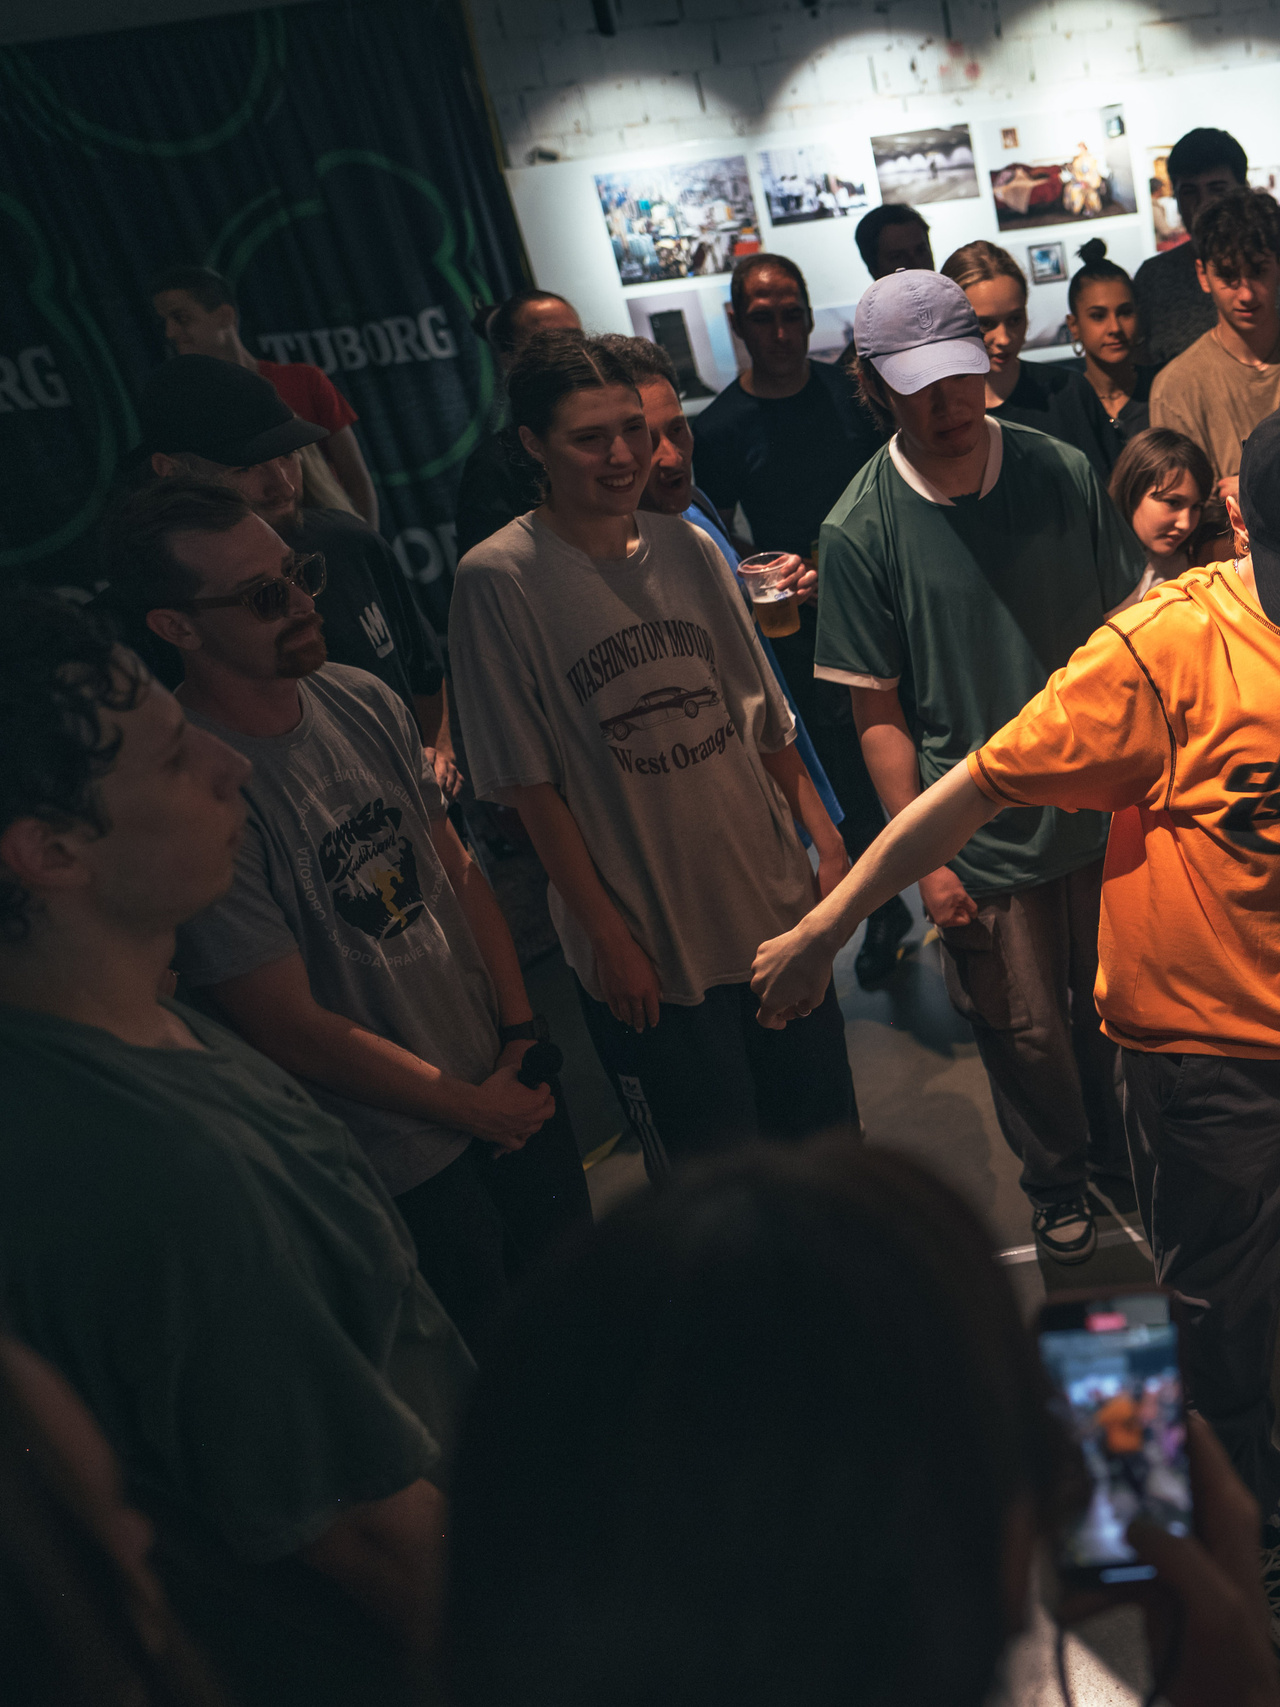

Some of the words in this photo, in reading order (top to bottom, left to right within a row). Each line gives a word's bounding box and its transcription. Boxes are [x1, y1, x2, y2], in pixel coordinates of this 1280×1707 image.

[259, 306, 458, 375] TUBORG
[566, 622, 667, 707] WASHINGTON
[607, 744, 671, 775] West
[671, 719, 735, 769] Orange
[296, 846, 327, 921] СВОБОДА
